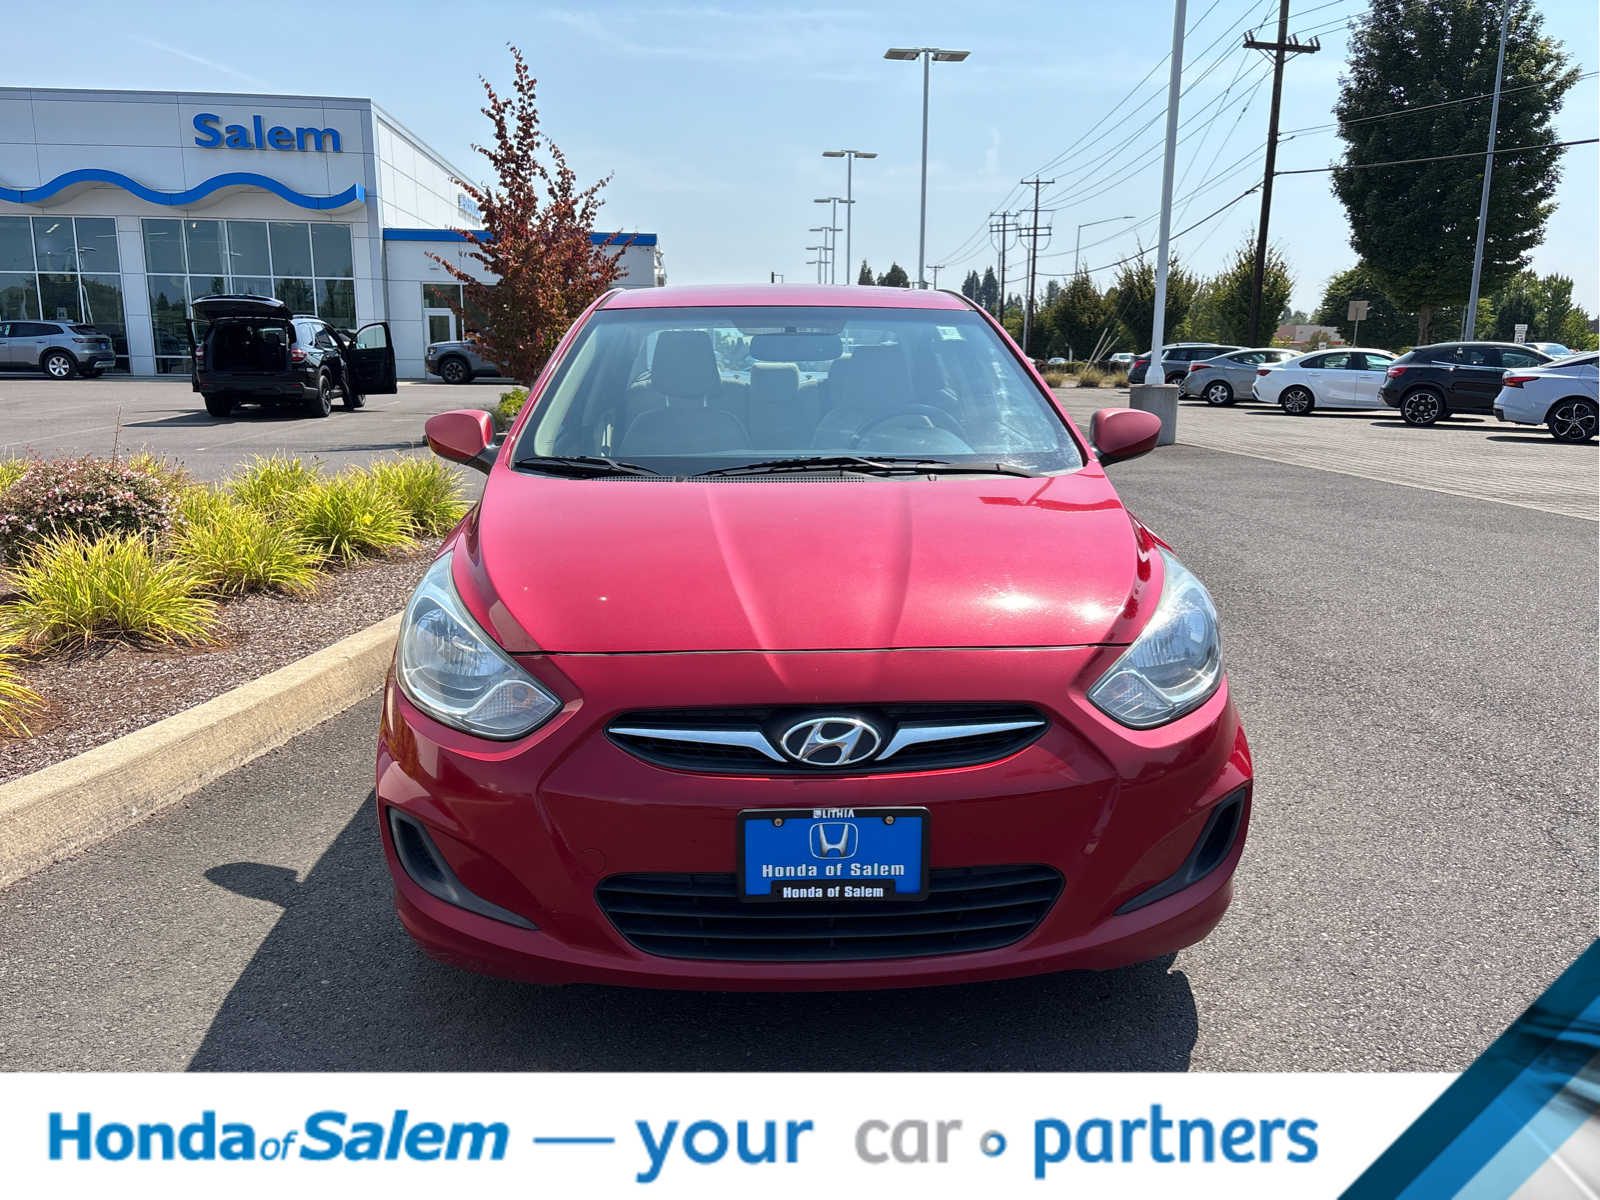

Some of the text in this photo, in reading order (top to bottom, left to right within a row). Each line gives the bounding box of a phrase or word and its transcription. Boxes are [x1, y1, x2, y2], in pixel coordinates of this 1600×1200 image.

[192, 112, 342, 153] Salem
[822, 808, 855, 819] LITHIA
[762, 862, 905, 877] Honda of Salem
[783, 885, 884, 898] Honda of Salem
